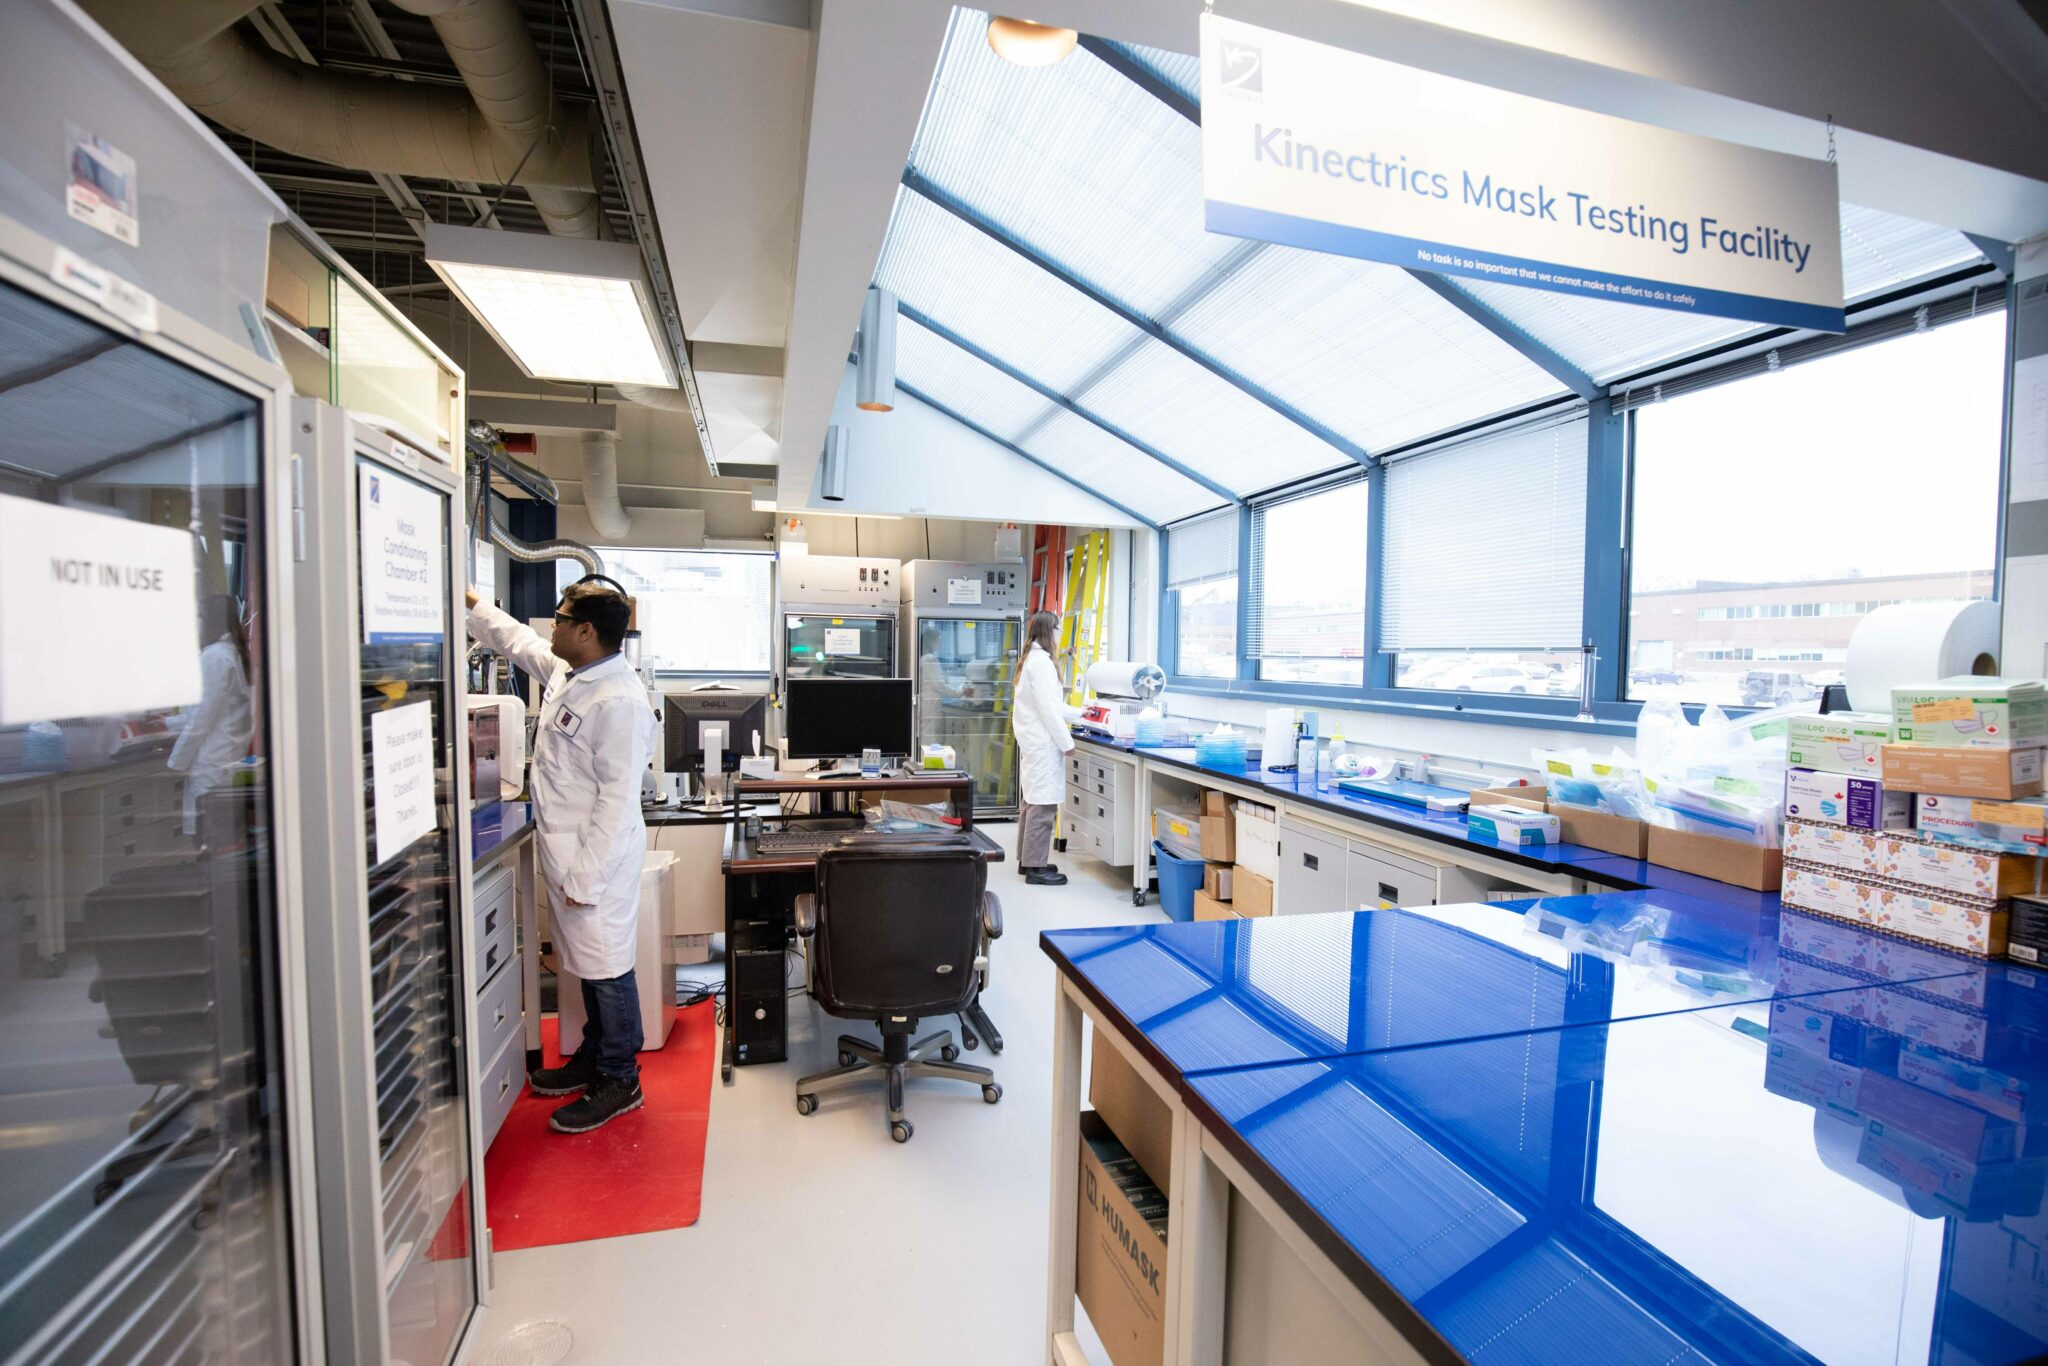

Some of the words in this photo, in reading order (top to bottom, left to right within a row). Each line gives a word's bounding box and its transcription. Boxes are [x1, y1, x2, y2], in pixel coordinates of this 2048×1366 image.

[1254, 123, 1449, 200] Kinectrics
[1462, 170, 1558, 221] Mask
[1567, 191, 1689, 254] Testing
[1700, 216, 1811, 273] Facility
[1417, 249, 1431, 261] No
[1433, 252, 1453, 265] task
[1454, 255, 1462, 267] is
[1463, 259, 1474, 269] so
[1475, 259, 1518, 276] important
[1519, 268, 1538, 280] that
[1538, 272, 1552, 282] we
[1553, 274, 1581, 287] cannot
[1582, 280, 1606, 292] make
[1606, 282, 1620, 293] the
[1621, 285, 1643, 297] effort
[1644, 289, 1653, 299] to
[1654, 290, 1664, 300] do
[1665, 291, 1672, 302] it
[1672, 294, 1697, 307] safely
[396, 515, 416, 537] Mask
[384, 536, 428, 566] Conditioning
[50, 557, 92, 585] NOT
[99, 563, 120, 587] IN
[126, 566, 163, 591] USE
[385, 560, 418, 582] Chamber
[701, 700, 728, 708] DELL
[386, 733, 406, 748] Please
[407, 728, 423, 741] make
[388, 761, 402, 775] sure
[403, 754, 416, 769] door
[1850, 781, 1862, 789] 50
[1922, 815, 1976, 829] PROCEDURE
[1101, 1194, 1160, 1296] HUMASK
